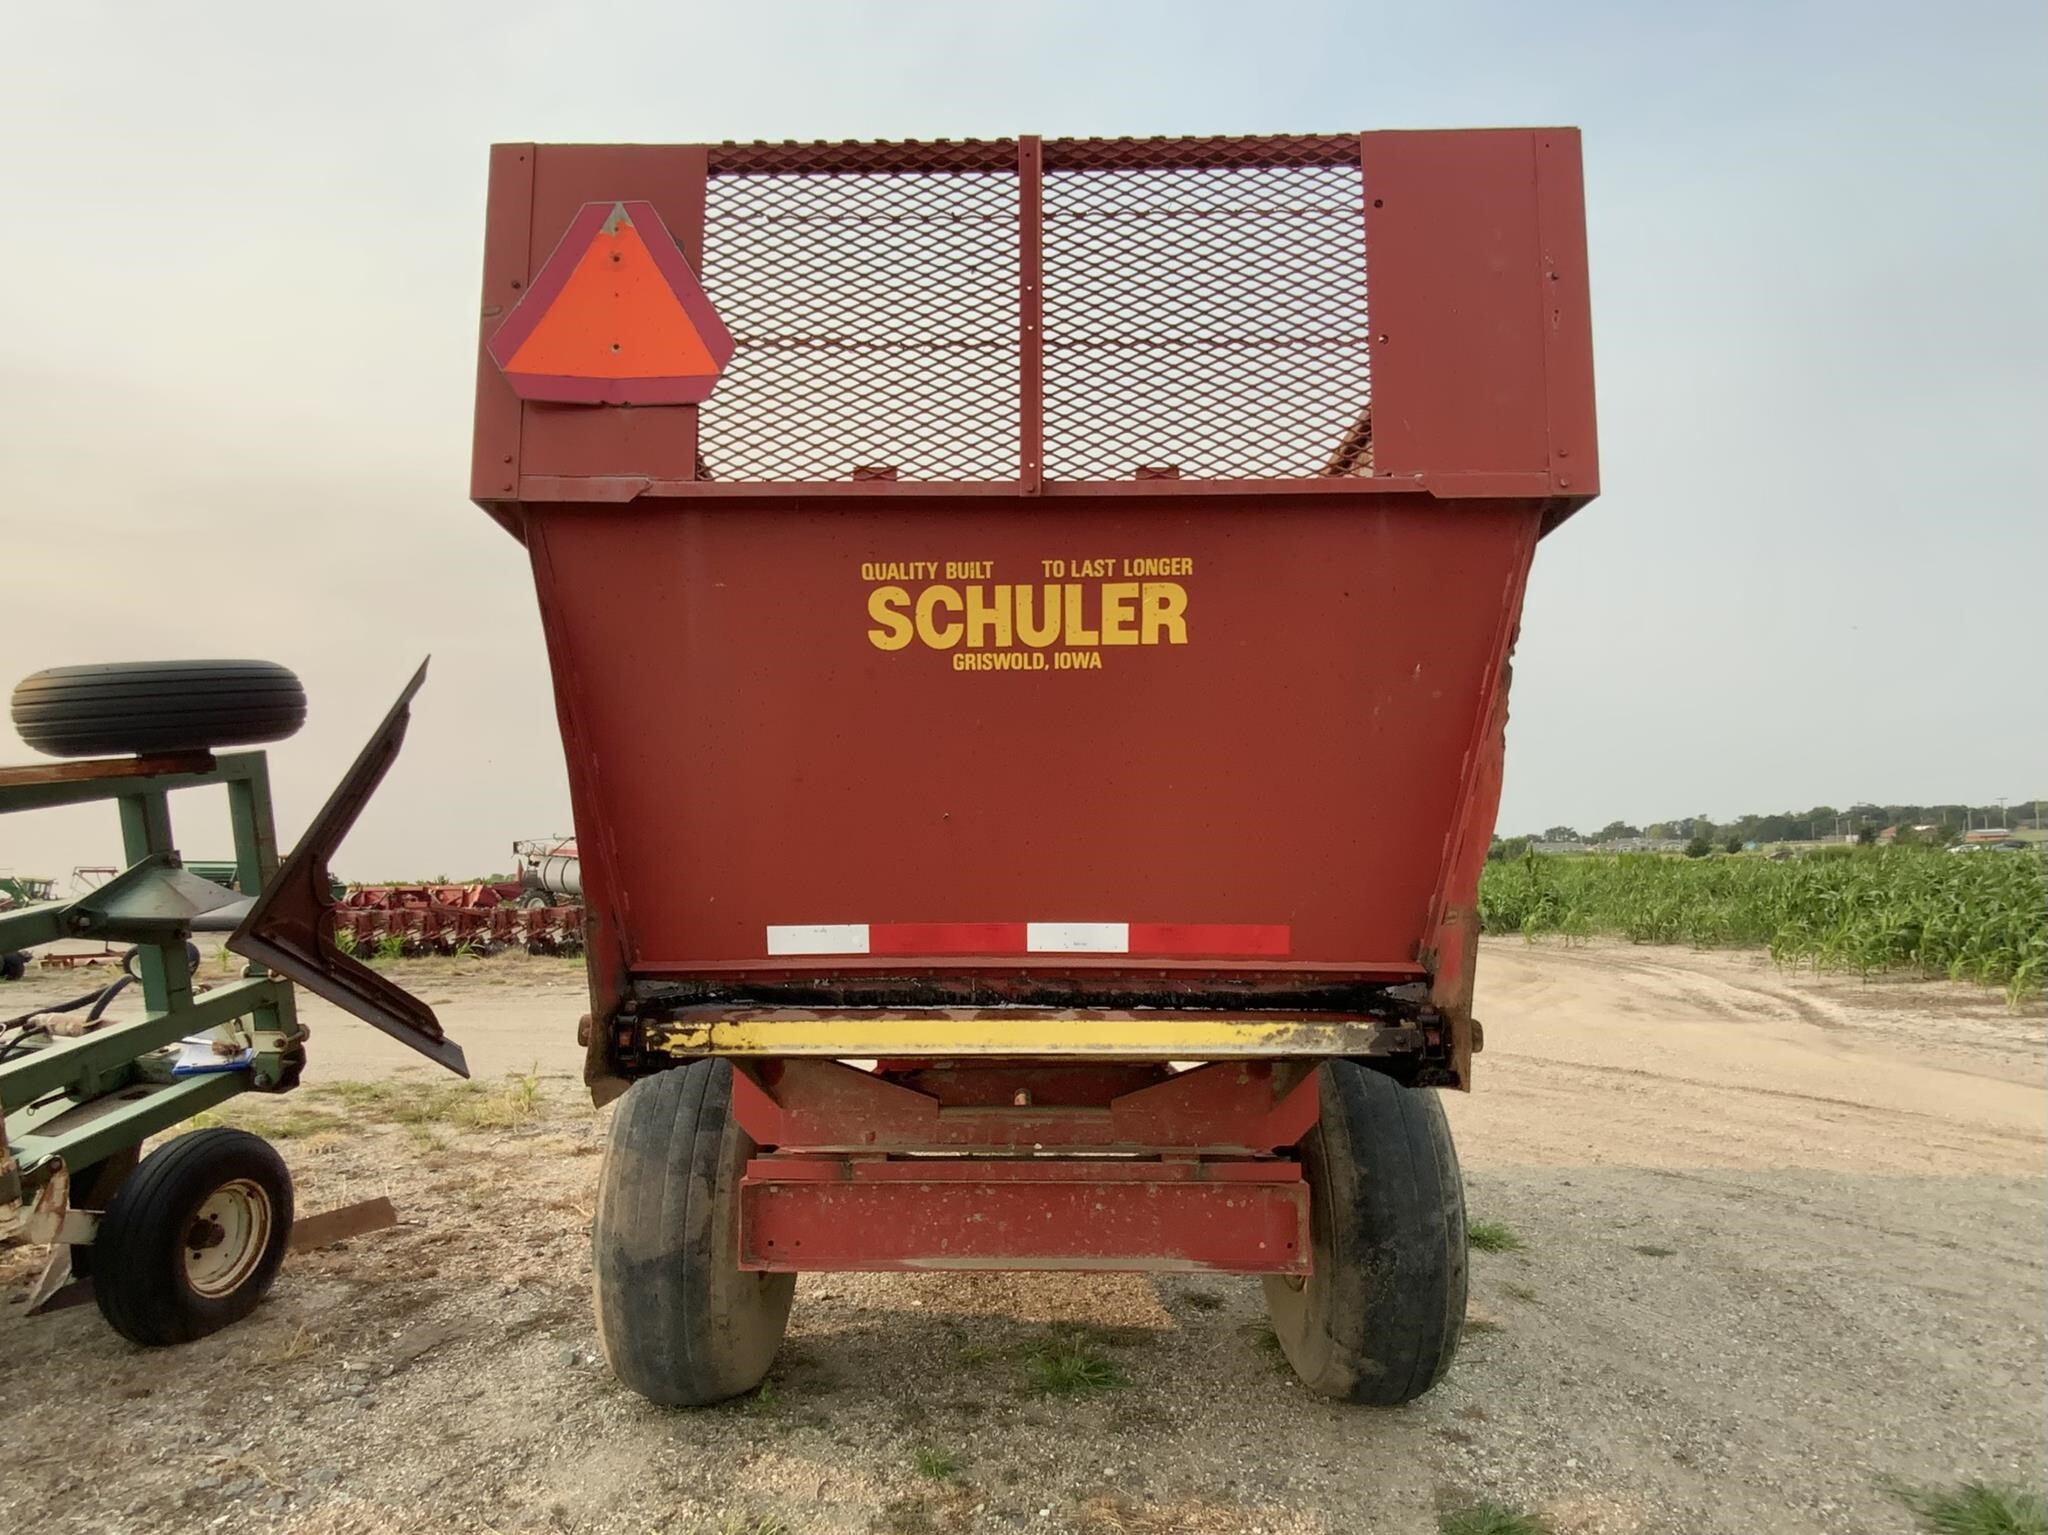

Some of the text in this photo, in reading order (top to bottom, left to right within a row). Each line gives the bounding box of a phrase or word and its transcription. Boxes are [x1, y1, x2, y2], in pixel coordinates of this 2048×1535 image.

[861, 557, 1193, 581] QUALITY BUILT TO LAST LONGER
[867, 582, 1189, 651] SCHULER
[952, 651, 1102, 672] GRISWOLD, IOWA
